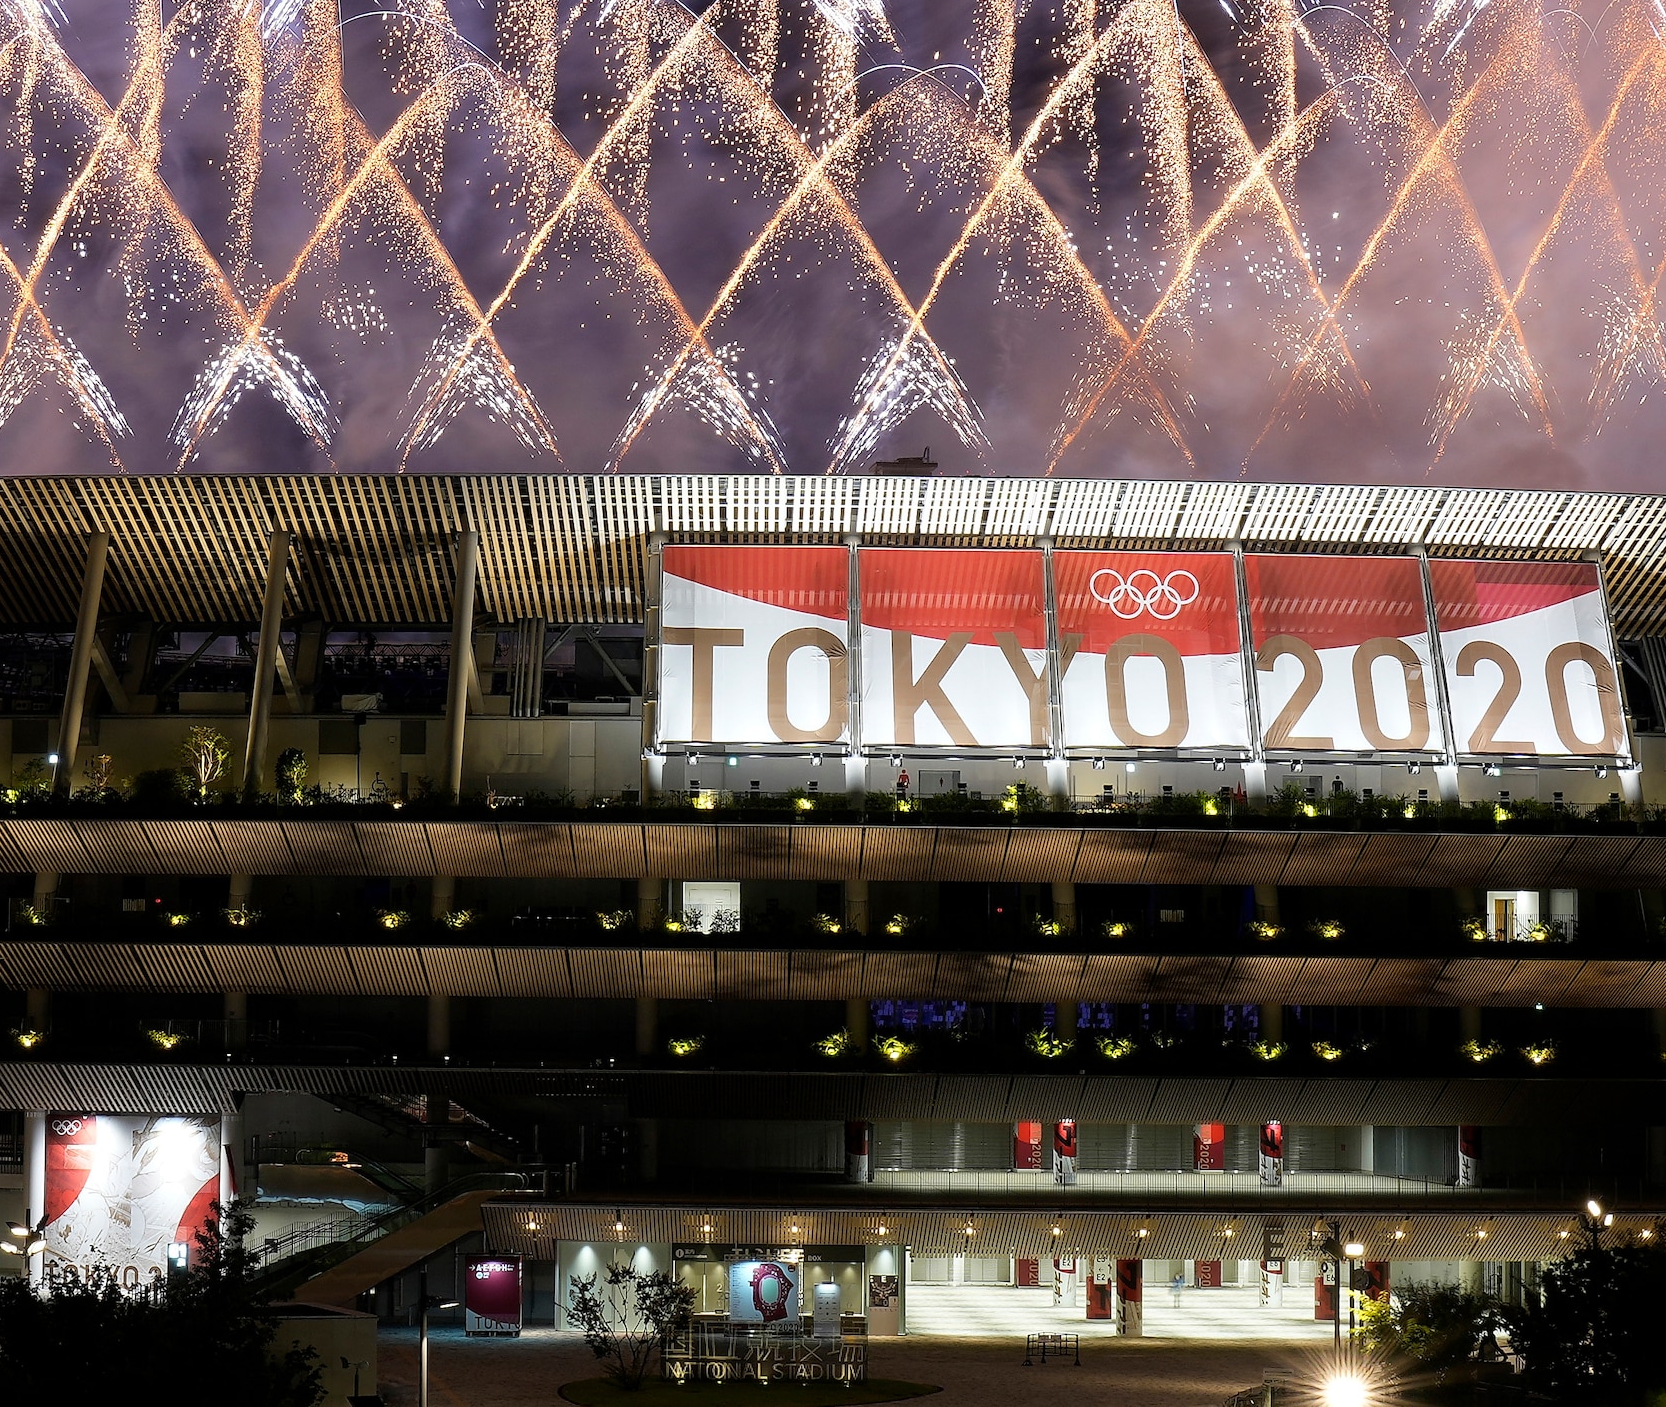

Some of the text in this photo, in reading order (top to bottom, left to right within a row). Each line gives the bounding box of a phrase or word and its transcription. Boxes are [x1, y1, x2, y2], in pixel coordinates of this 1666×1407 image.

[661, 626, 1623, 755] TOKYO 2020
[665, 1361, 864, 1380] NATIONAL STADIUM
